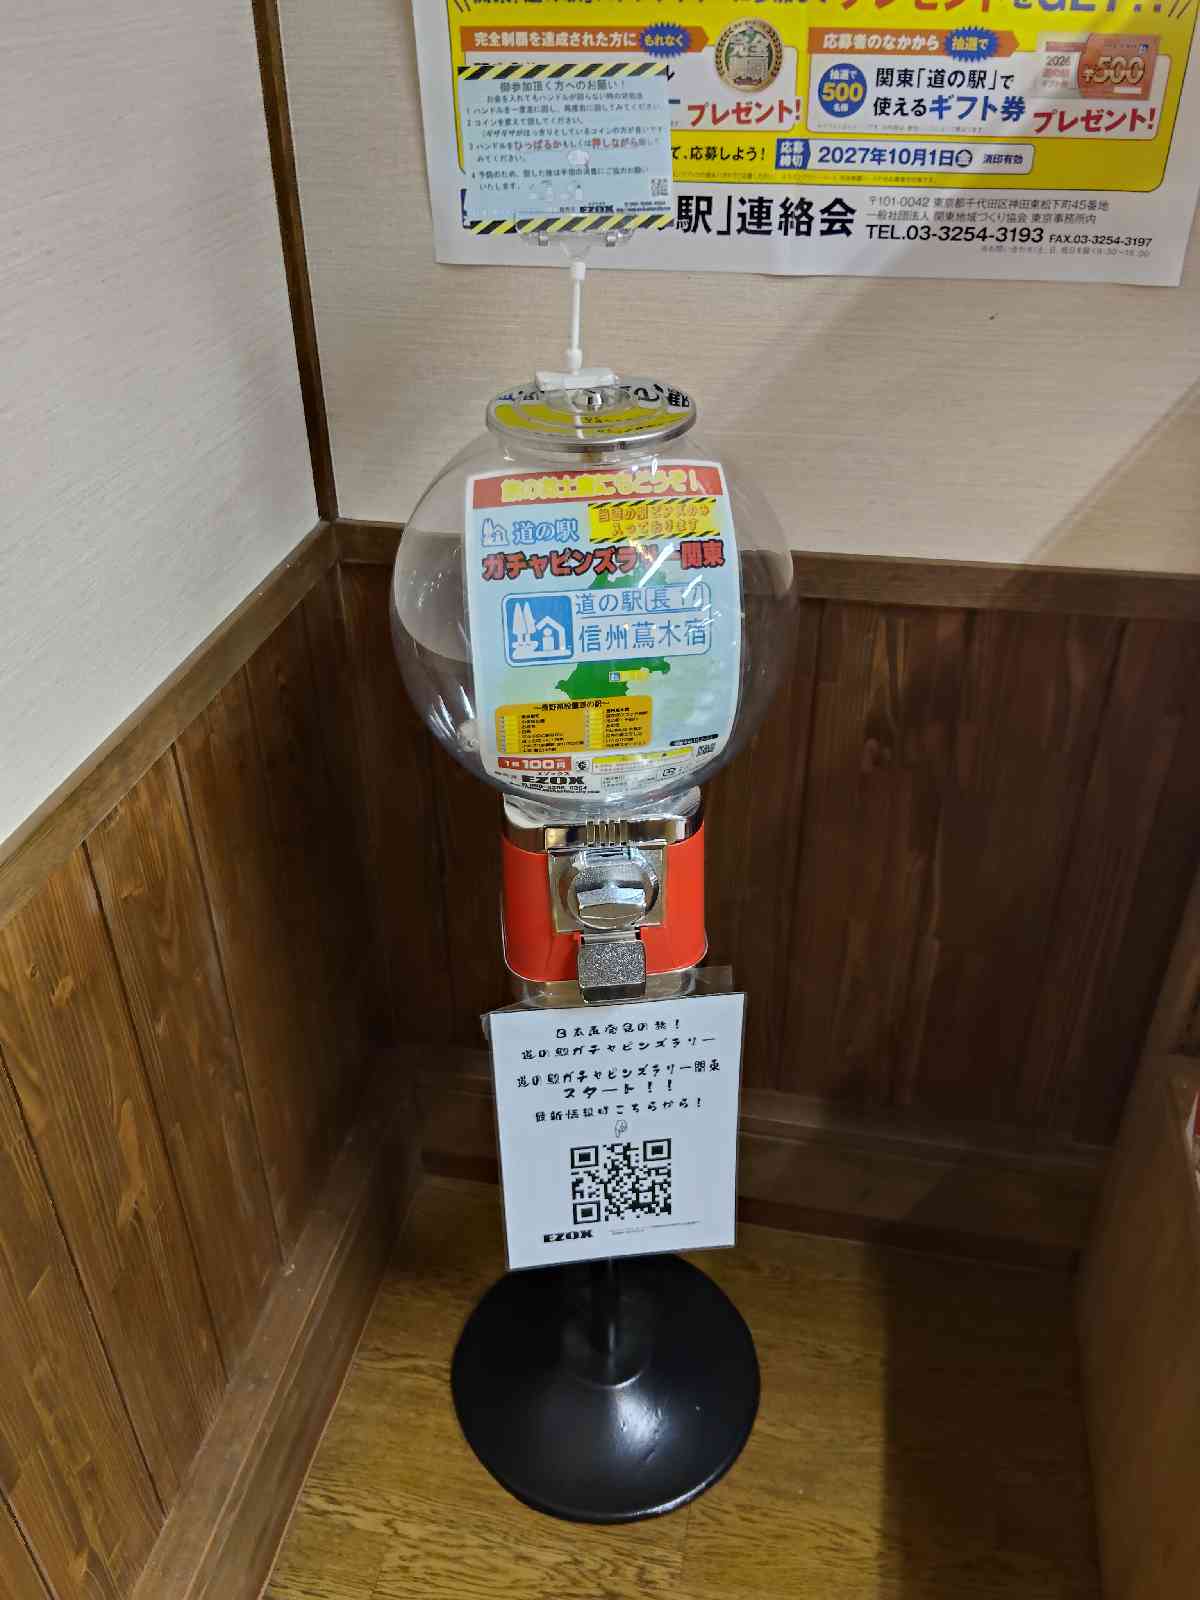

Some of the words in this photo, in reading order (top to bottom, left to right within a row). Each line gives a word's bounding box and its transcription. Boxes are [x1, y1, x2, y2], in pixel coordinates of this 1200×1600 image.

[823, 34, 939, 50] 応募者のなかから
[875, 67, 1014, 90] 関東「道の駅」で
[822, 81, 864, 102] 500
[873, 94, 1025, 122] 使えるギフト券
[983, 153, 1024, 165] 消印有効
[676, 195, 856, 237] 駅」連絡会
[866, 210, 929, 221] 一般社団法人
[933, 211, 1028, 223] 関東地域づくり協会
[865, 224, 1044, 243] TEL.03-3254-3193
[1048, 234, 1153, 248] FAX.03-3254-3197
[512, 518, 579, 545] 道の駅
[575, 589, 642, 615] 道の駅
[652, 587, 703, 609] 長
[579, 618, 707, 653] 信州蔦木宿
[522, 775, 584, 785] EZOX
[543, 1229, 593, 1243] EZOX
